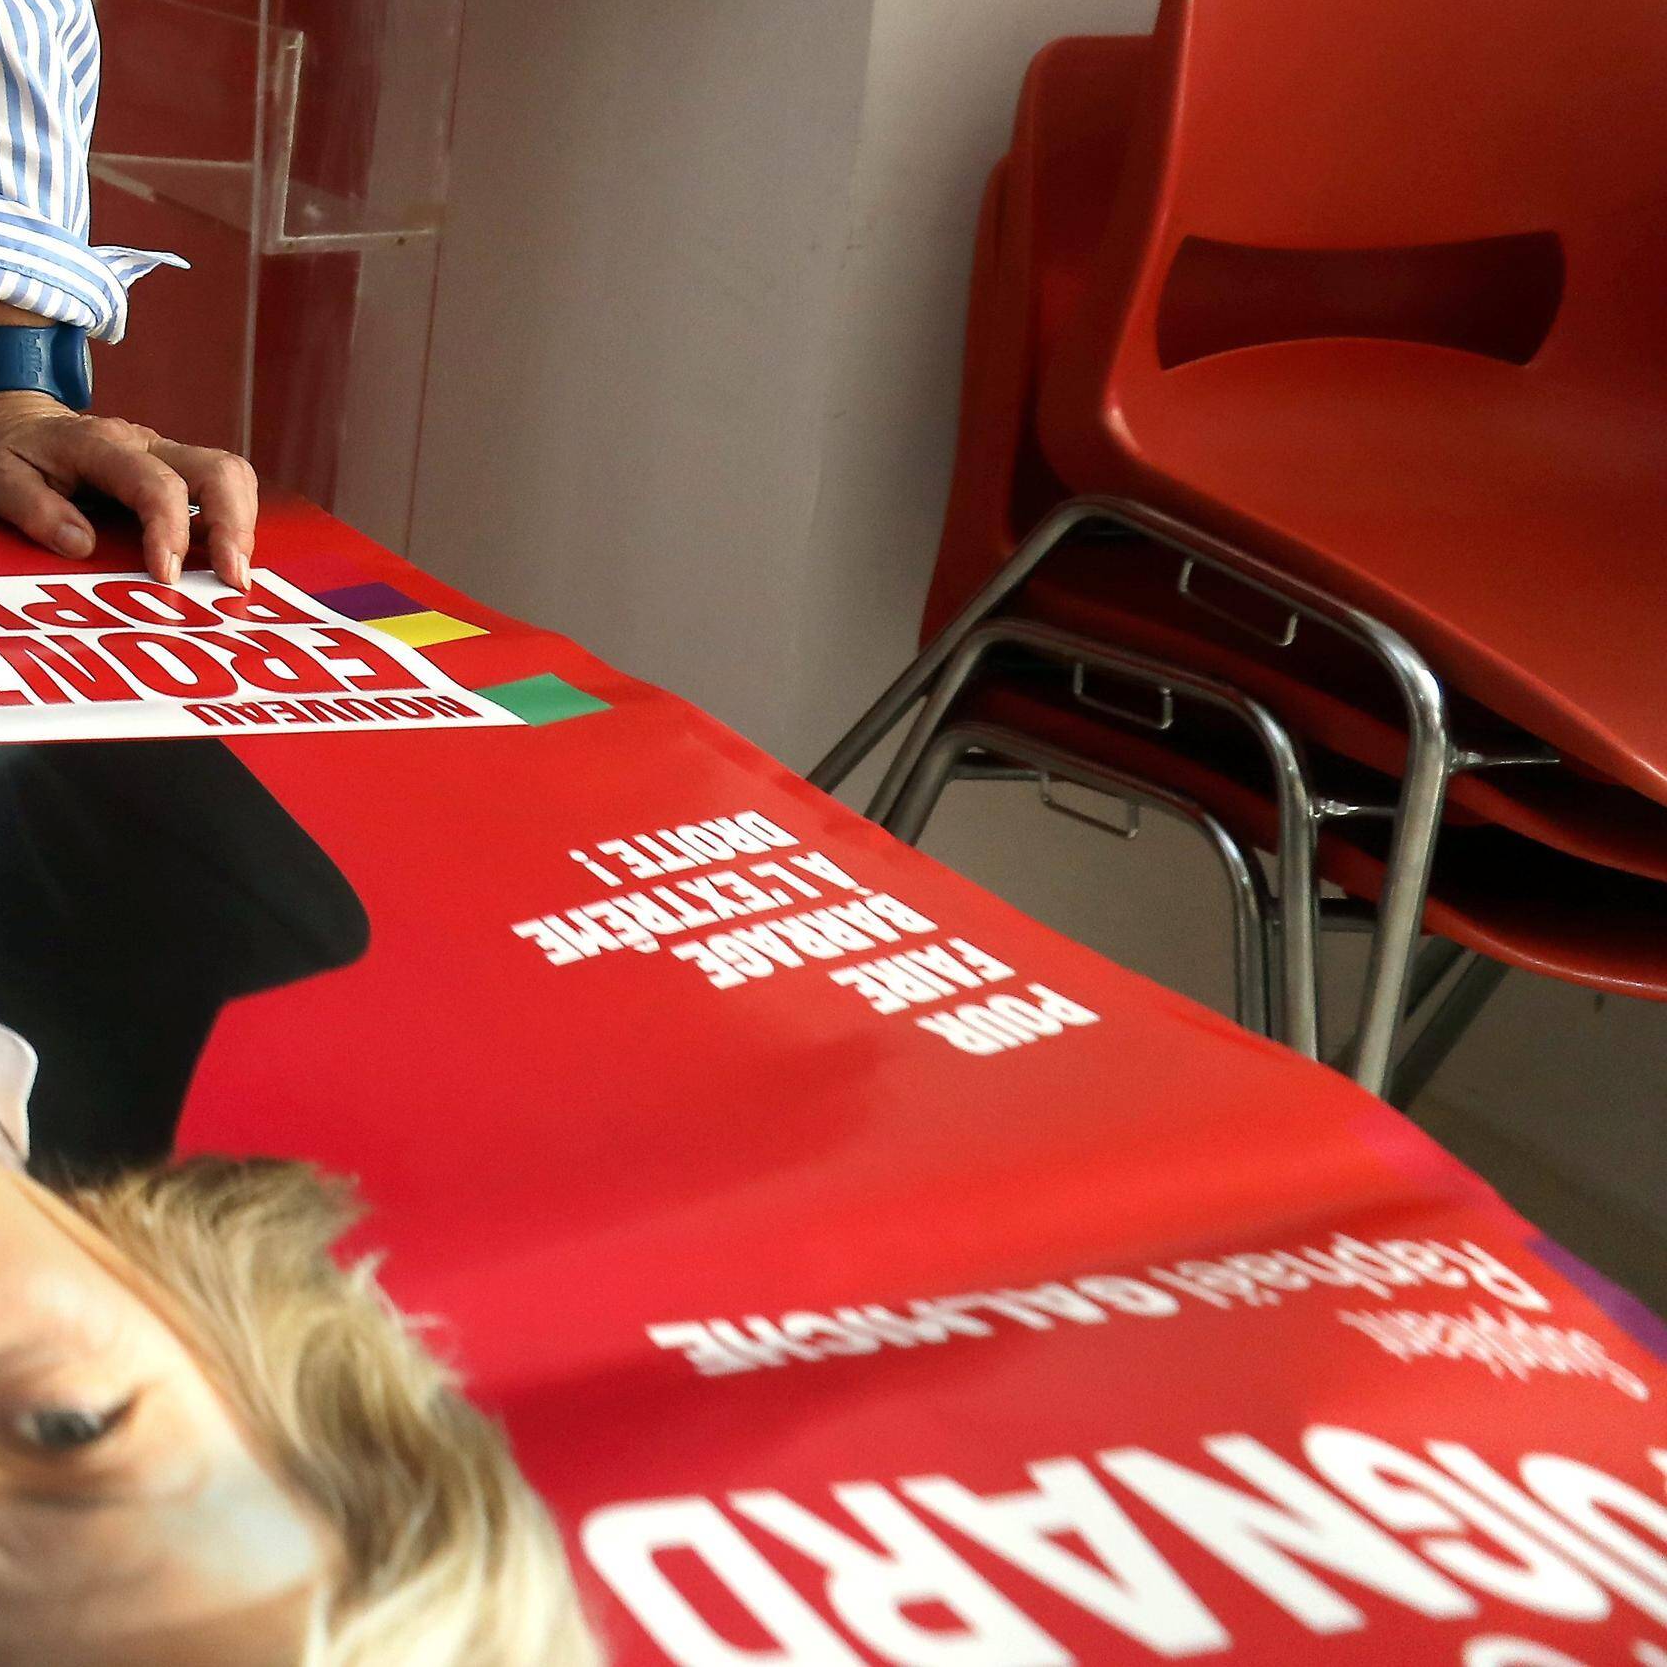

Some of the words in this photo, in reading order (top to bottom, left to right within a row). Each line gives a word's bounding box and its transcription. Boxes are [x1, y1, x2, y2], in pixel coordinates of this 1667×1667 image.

[184, 696, 482, 727] NOUVEAU
[569, 848, 623, 887] !
[597, 810, 799, 879] DROITE
[669, 891, 938, 990] BARRAGE
[829, 937, 1015, 1015] FAIRE
[915, 983, 1100, 1056] POUR
[1149, 1231, 1552, 1313] Raphaël
[645, 1276, 1182, 1378] GALMICHE
